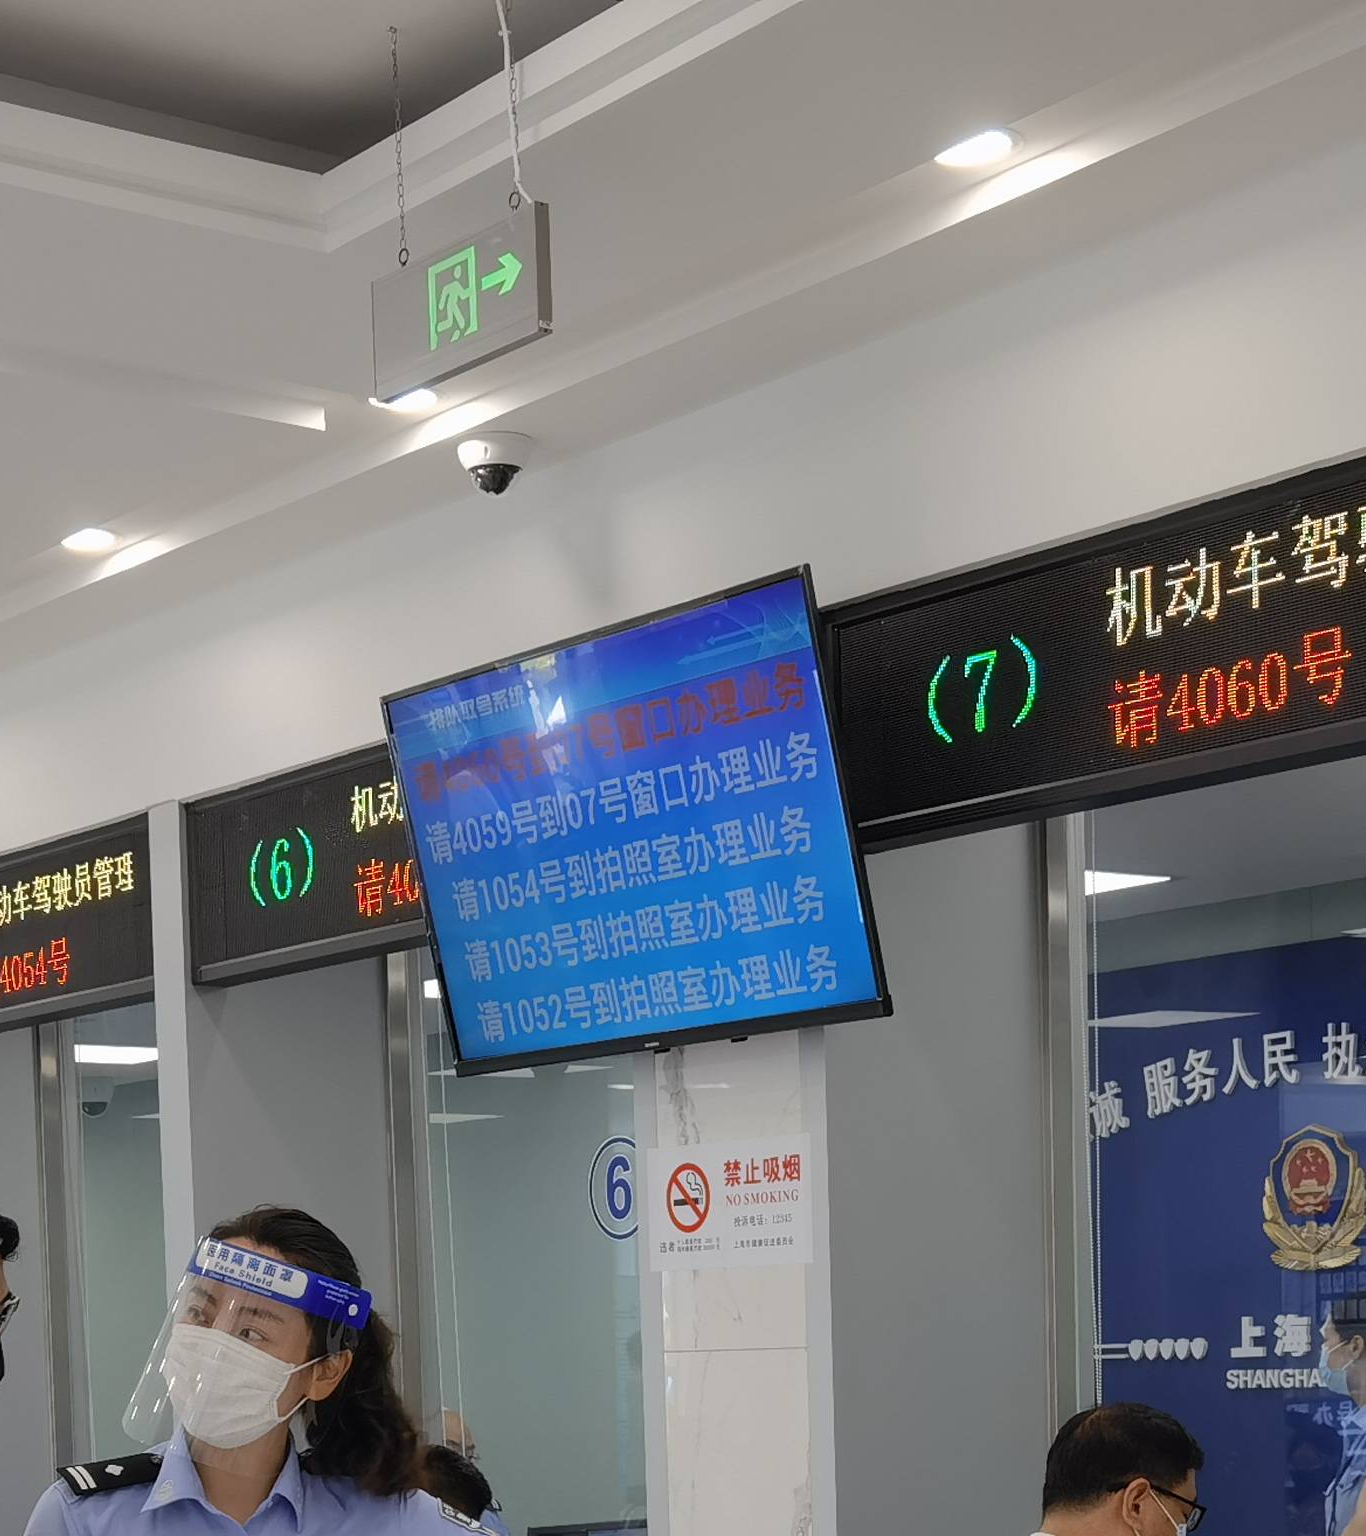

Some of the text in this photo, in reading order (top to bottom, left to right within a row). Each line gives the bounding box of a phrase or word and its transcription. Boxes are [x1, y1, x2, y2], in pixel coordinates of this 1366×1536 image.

[928, 634, 1036, 744] (7)
[1108, 626, 1352, 748] 请4060号
[425, 732, 818, 865] 请4059号到07号窗口办理业务
[250, 826, 315, 907] (6)
[452, 805, 812, 923] 请1054号到拍照室办理业务
[464, 875, 825, 984] 请1053号到拍照室办理业务
[477, 944, 837, 1043] 请1052号到拍照室办理业务
[1143, 1030, 1300, 1119] 服务人民
[606, 1154, 633, 1221] 6
[723, 1154, 801, 1187] 禁止吸烟
[725, 1189, 800, 1207] NO SMOKING
[215, 1261, 235, 1274] Face
[238, 1270, 273, 1287] Shield
[1230, 1314, 1312, 1358] 上海
[1226, 1368, 1327, 1390] SHANGHA
